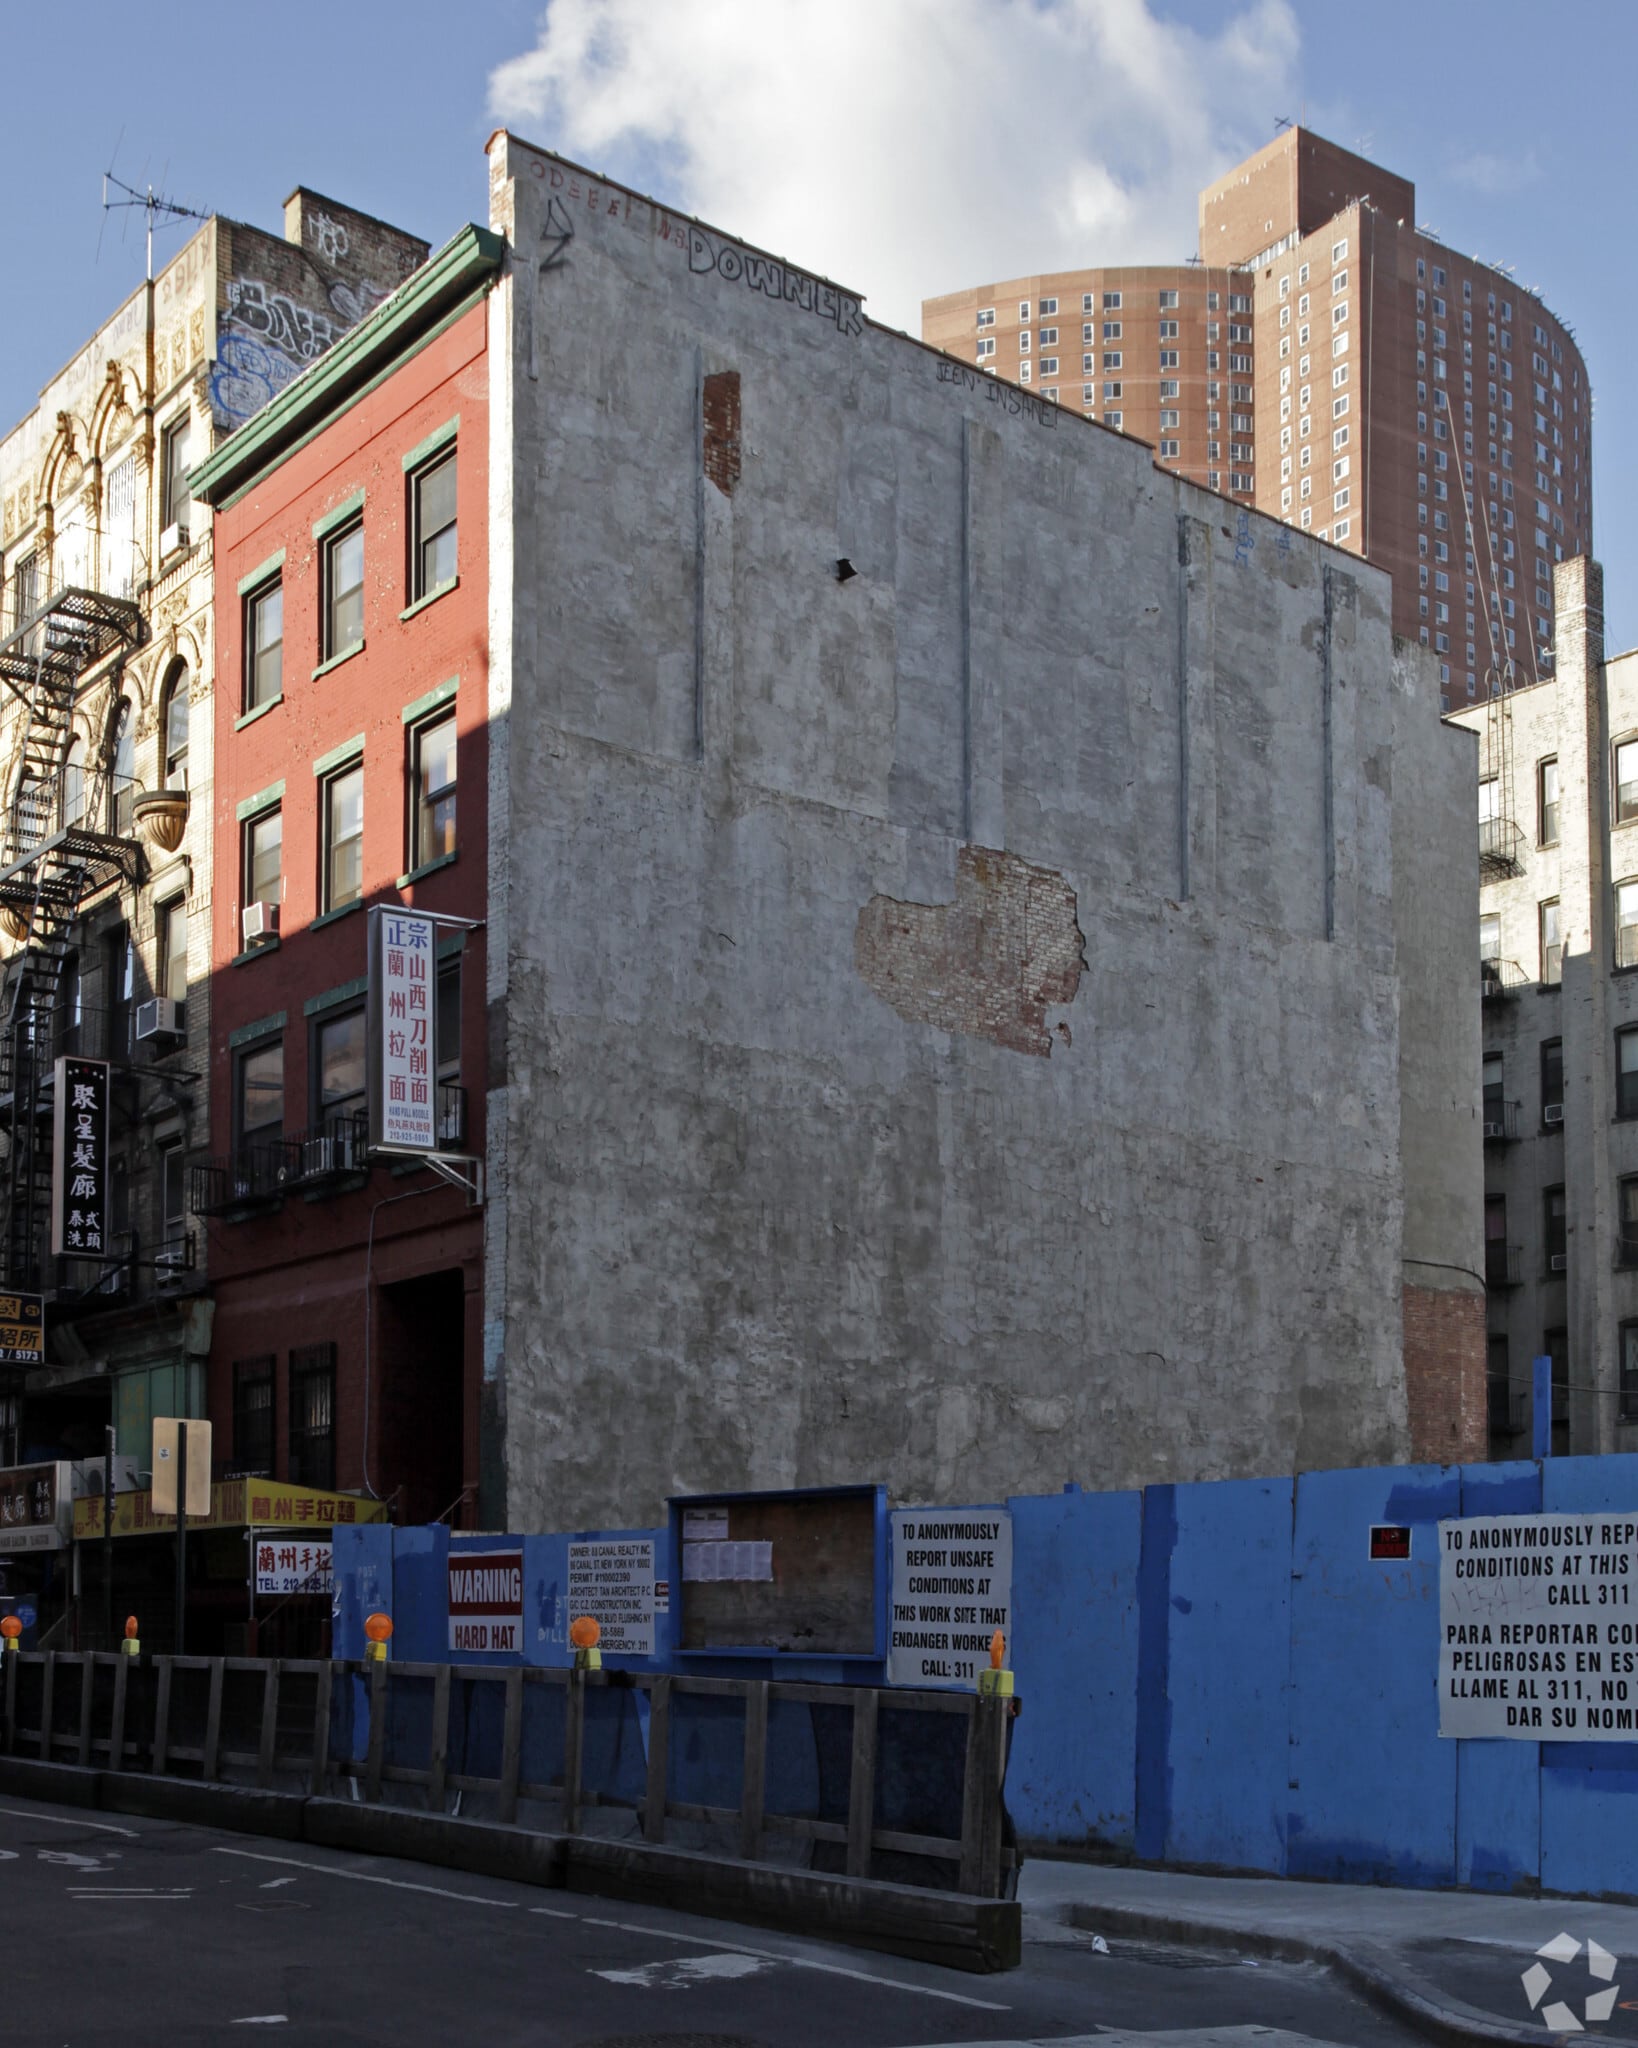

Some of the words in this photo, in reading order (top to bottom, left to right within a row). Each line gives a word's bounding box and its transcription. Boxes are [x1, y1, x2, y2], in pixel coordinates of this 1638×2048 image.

[688, 227, 864, 337] DOWNER
[387, 918, 428, 949] 正宗
[16, 1350, 39, 1360] 5173
[252, 1497, 356, 1522] 蘭州手拉麵
[903, 1524, 914, 1539] TO
[918, 1523, 1000, 1540] ANONYMOUSLY
[1446, 1530, 1463, 1550] TO
[1469, 1525, 1593, 1548] ANONYMOUSLY
[1601, 1524, 1638, 1545] REP
[599, 1546, 616, 1556] CANAL
[618, 1545, 639, 1555] REALTY
[906, 1550, 947, 1566] REPORT
[950, 1551, 994, 1568] UNSAFE
[577, 1560, 592, 1569] CANAL
[601, 1560, 612, 1569] NEW
[614, 1560, 626, 1568] YORK
[628, 1560, 635, 1568] NY
[1456, 1556, 1553, 1578] CONDITIONS
[1562, 1556, 1582, 1576] AT
[1590, 1554, 1629, 1575] THIS
[258, 1579, 278, 1590] TEL:
[450, 1568, 520, 1603] WARNING
[570, 1573, 593, 1583] PERMIT
[909, 1577, 974, 1595] CONDITIONS
[977, 1579, 991, 1595] AT
[611, 1586, 640, 1596] ARCHITECT
[1548, 1584, 1590, 1605] CALL
[1598, 1584, 1629, 1605] 311
[591, 1600, 631, 1610] CONSTRUCTION
[894, 1605, 916, 1621] THIS
[919, 1606, 950, 1622] WORK
[980, 1608, 1006, 1624] THAT
[618, 1613, 643, 1623] FLUSHING
[644, 1613, 651, 1623] NY
[455, 1625, 487, 1649] HARD
[492, 1625, 515, 1649] HAT
[892, 1632, 949, 1650] ENDANGER
[1447, 1625, 1492, 1644] PARA
[1500, 1624, 1598, 1645] REPORTAR
[1608, 1624, 1638, 1645] CO
[638, 1640, 648, 1650] 311
[921, 1659, 951, 1677] CALL:
[954, 1662, 974, 1679] 311
[1453, 1652, 1566, 1672] PELIGROSAS
[1576, 1652, 1601, 1672] EN
[1611, 1652, 1638, 1672] ES
[1451, 1679, 1508, 1698] LLAME
[1517, 1679, 1538, 1699] AL
[1547, 1679, 1592, 1702] 311,
[1601, 1680, 1627, 1700] NO
[1506, 1707, 1542, 1727] DAR
[1552, 1708, 1576, 1727] SU
[1587, 1708, 1638, 1729] NOM
